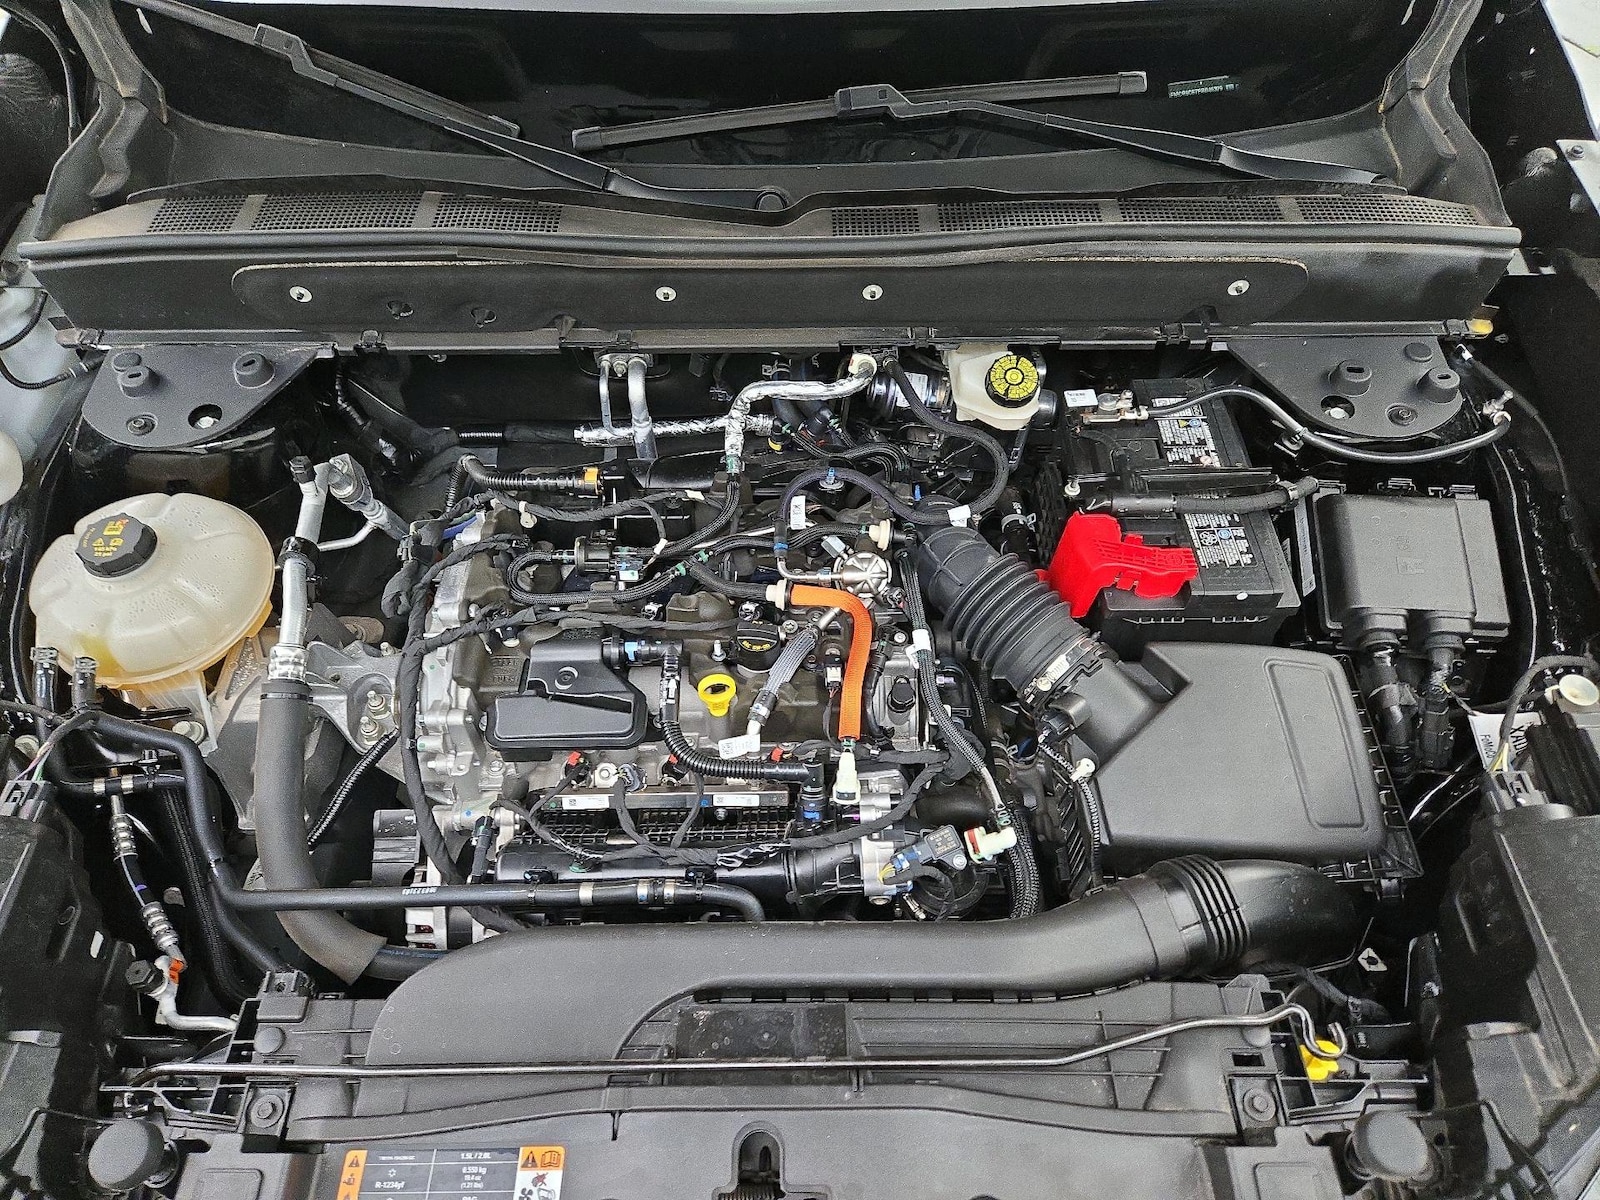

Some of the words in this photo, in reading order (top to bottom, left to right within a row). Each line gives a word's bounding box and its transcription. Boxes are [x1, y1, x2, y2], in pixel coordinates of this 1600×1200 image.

[1480, 734, 1497, 759] FoMoCo
[479, 1166, 487, 1175] kg
[375, 1181, 405, 1190] R-1234yf
